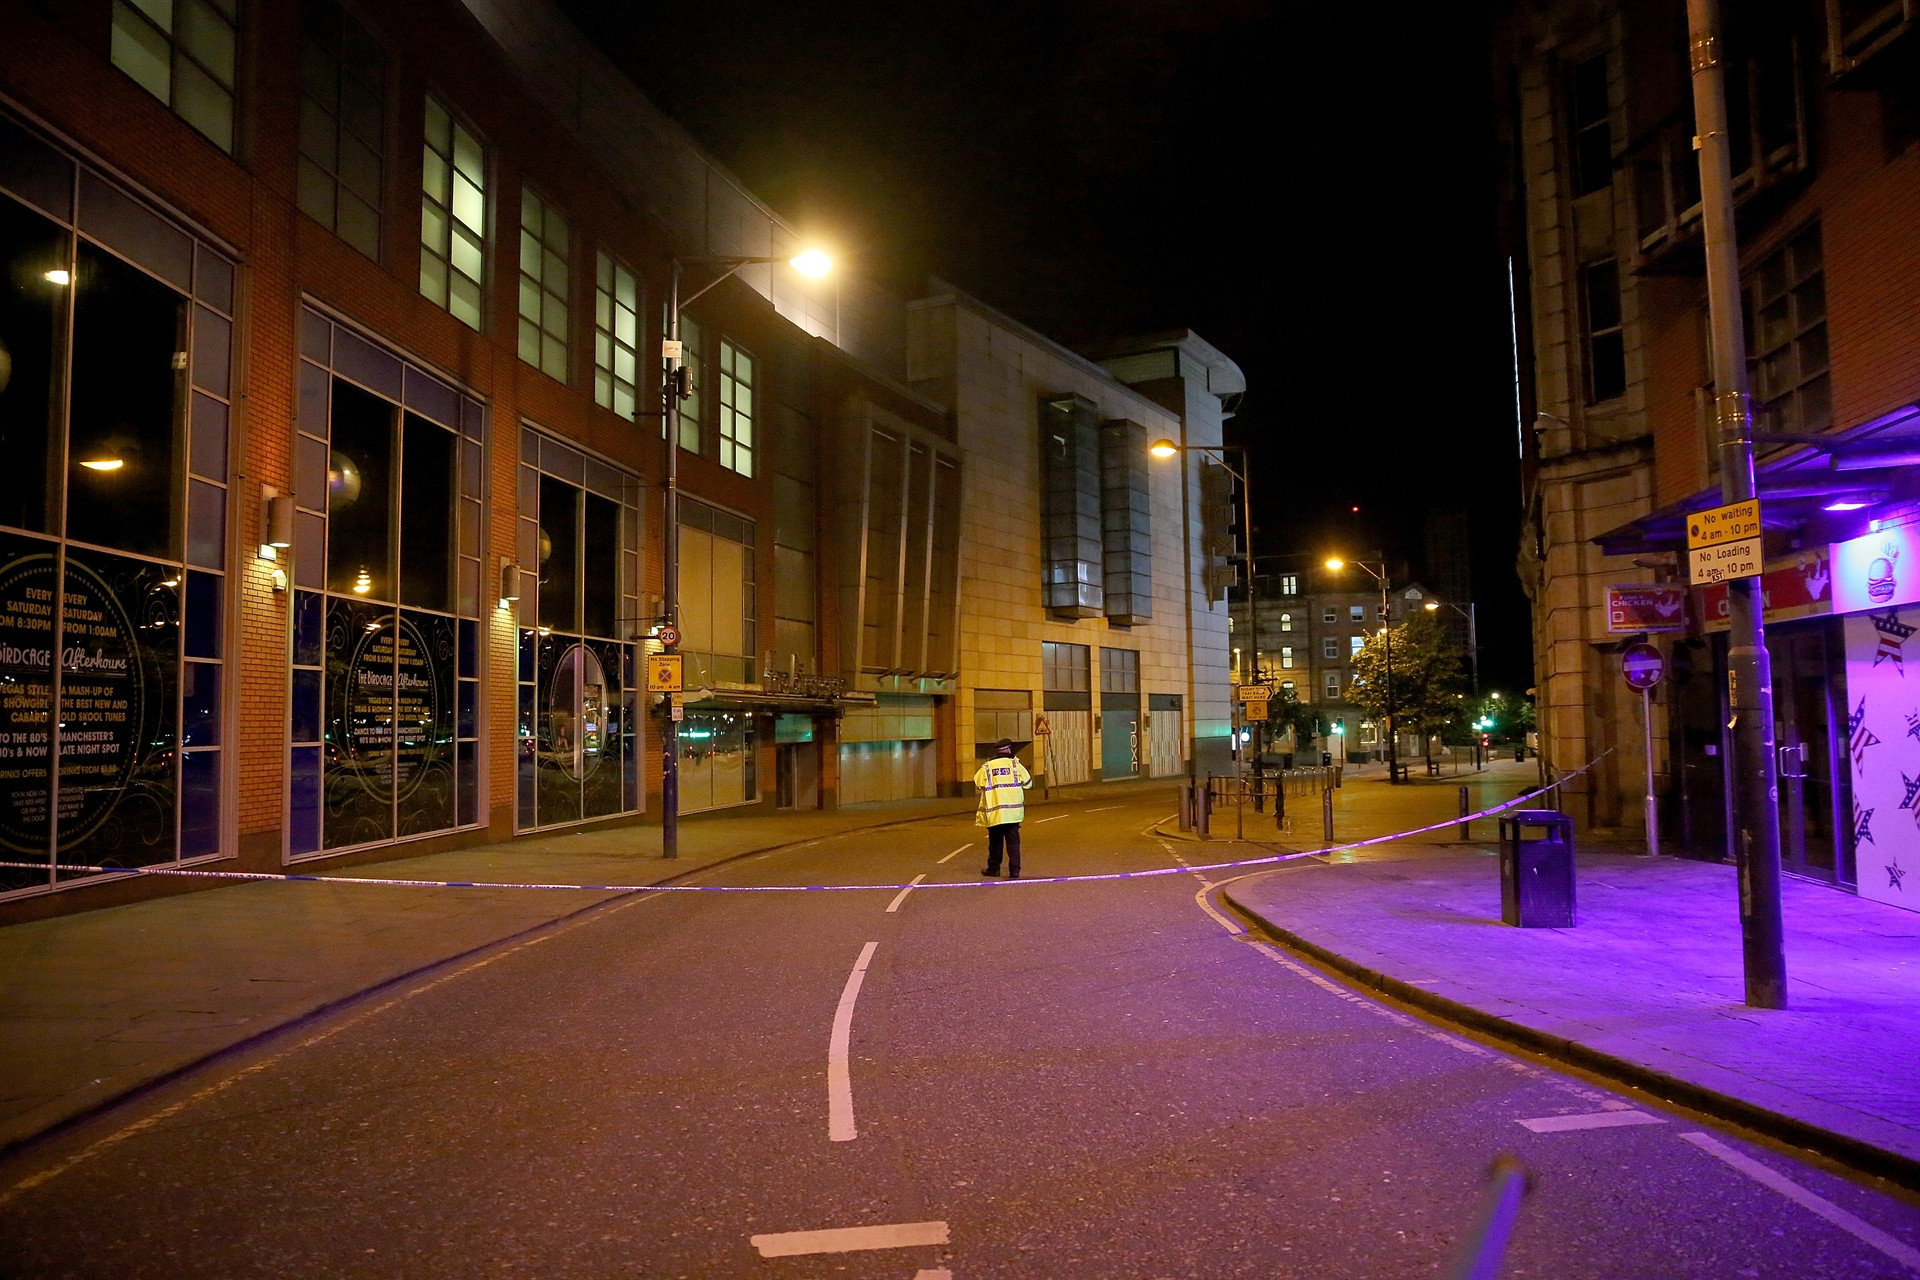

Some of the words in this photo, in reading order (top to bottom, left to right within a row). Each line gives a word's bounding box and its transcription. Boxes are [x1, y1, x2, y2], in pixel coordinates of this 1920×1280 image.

[1704, 515, 1716, 525] No
[1721, 506, 1752, 520] waiting
[1701, 531, 1707, 541] 4
[1710, 530, 1722, 539] am
[1730, 524, 1741, 535] 10
[1744, 522, 1757, 533] pm
[1700, 552, 1711, 562] No
[1717, 546, 1750, 559] Loading
[1698, 568, 1704, 577] 4
[1727, 562, 1737, 573] 10
[1740, 562, 1754, 573] pm
[26, 587, 52, 601] EVERY
[64, 592, 88, 606] EVERY
[7, 600, 52, 616] SATURDAY
[1612, 599, 1653, 607] CHICKEN
[63, 607, 103, 622] SATURDAY
[17, 617, 51, 631] 8:30PM
[63, 622, 86, 635] FROM
[89, 625, 117, 638] 1:00AM
[662, 632, 675, 640] 20
[0, 641, 51, 667] iRDCAGE
[62, 647, 127, 674] Afterhours
[27, 684, 50, 695] STYLE
[69, 685, 102, 696] MASH-UP
[104, 687, 114, 697] OF
[3, 698, 49, 709] SHOWGIRL
[61, 699, 74, 709] THE
[76, 699, 93, 709] BEST
[95, 699, 111, 709] NEW
[112, 700, 128, 710] AND
[10, 712, 49, 723] CABARET
[60, 712, 77, 722] OLD
[78, 712, 103, 722] SKOOL
[104, 712, 126, 722] TUNES
[12, 732, 28, 743] THE
[29, 732, 48, 743] 80'S
[59, 731, 114, 742] MANCHESTER'S
[17, 747, 23, 757] &
[26, 746, 48, 757] NOW
[77, 744, 101, 755] NIGHT
[101, 743, 120, 754] SPOT
[22, 768, 47, 779] OFFERS
[82, 765, 99, 775] FROM
